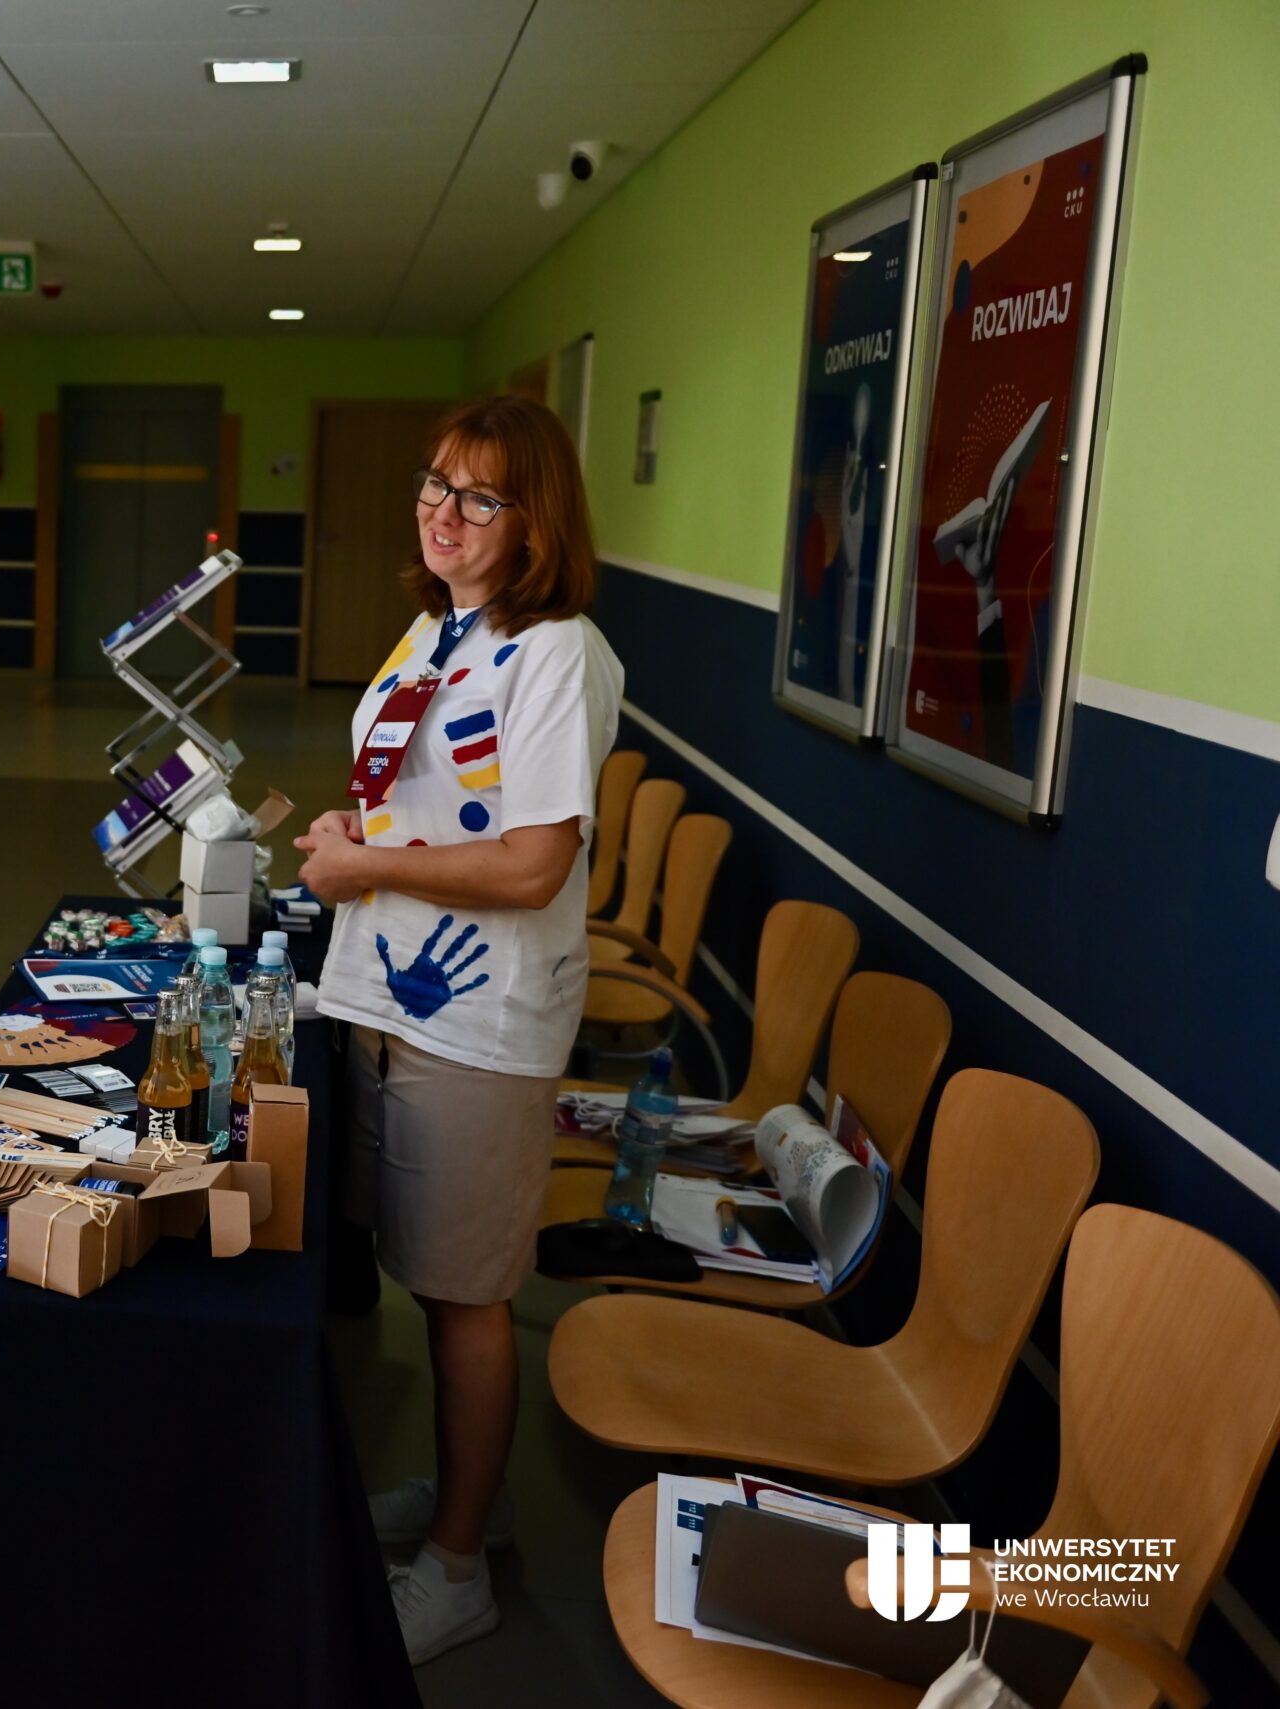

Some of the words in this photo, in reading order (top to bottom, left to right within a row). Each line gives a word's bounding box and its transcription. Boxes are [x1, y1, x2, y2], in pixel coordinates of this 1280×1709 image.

[1063, 202, 1084, 219] CKU
[971, 281, 1073, 343] ROZWIJAJ
[824, 329, 893, 375] ODKRYWAJ
[367, 756, 390, 767] ZESPÓŁ
[370, 766, 382, 775] CKU
